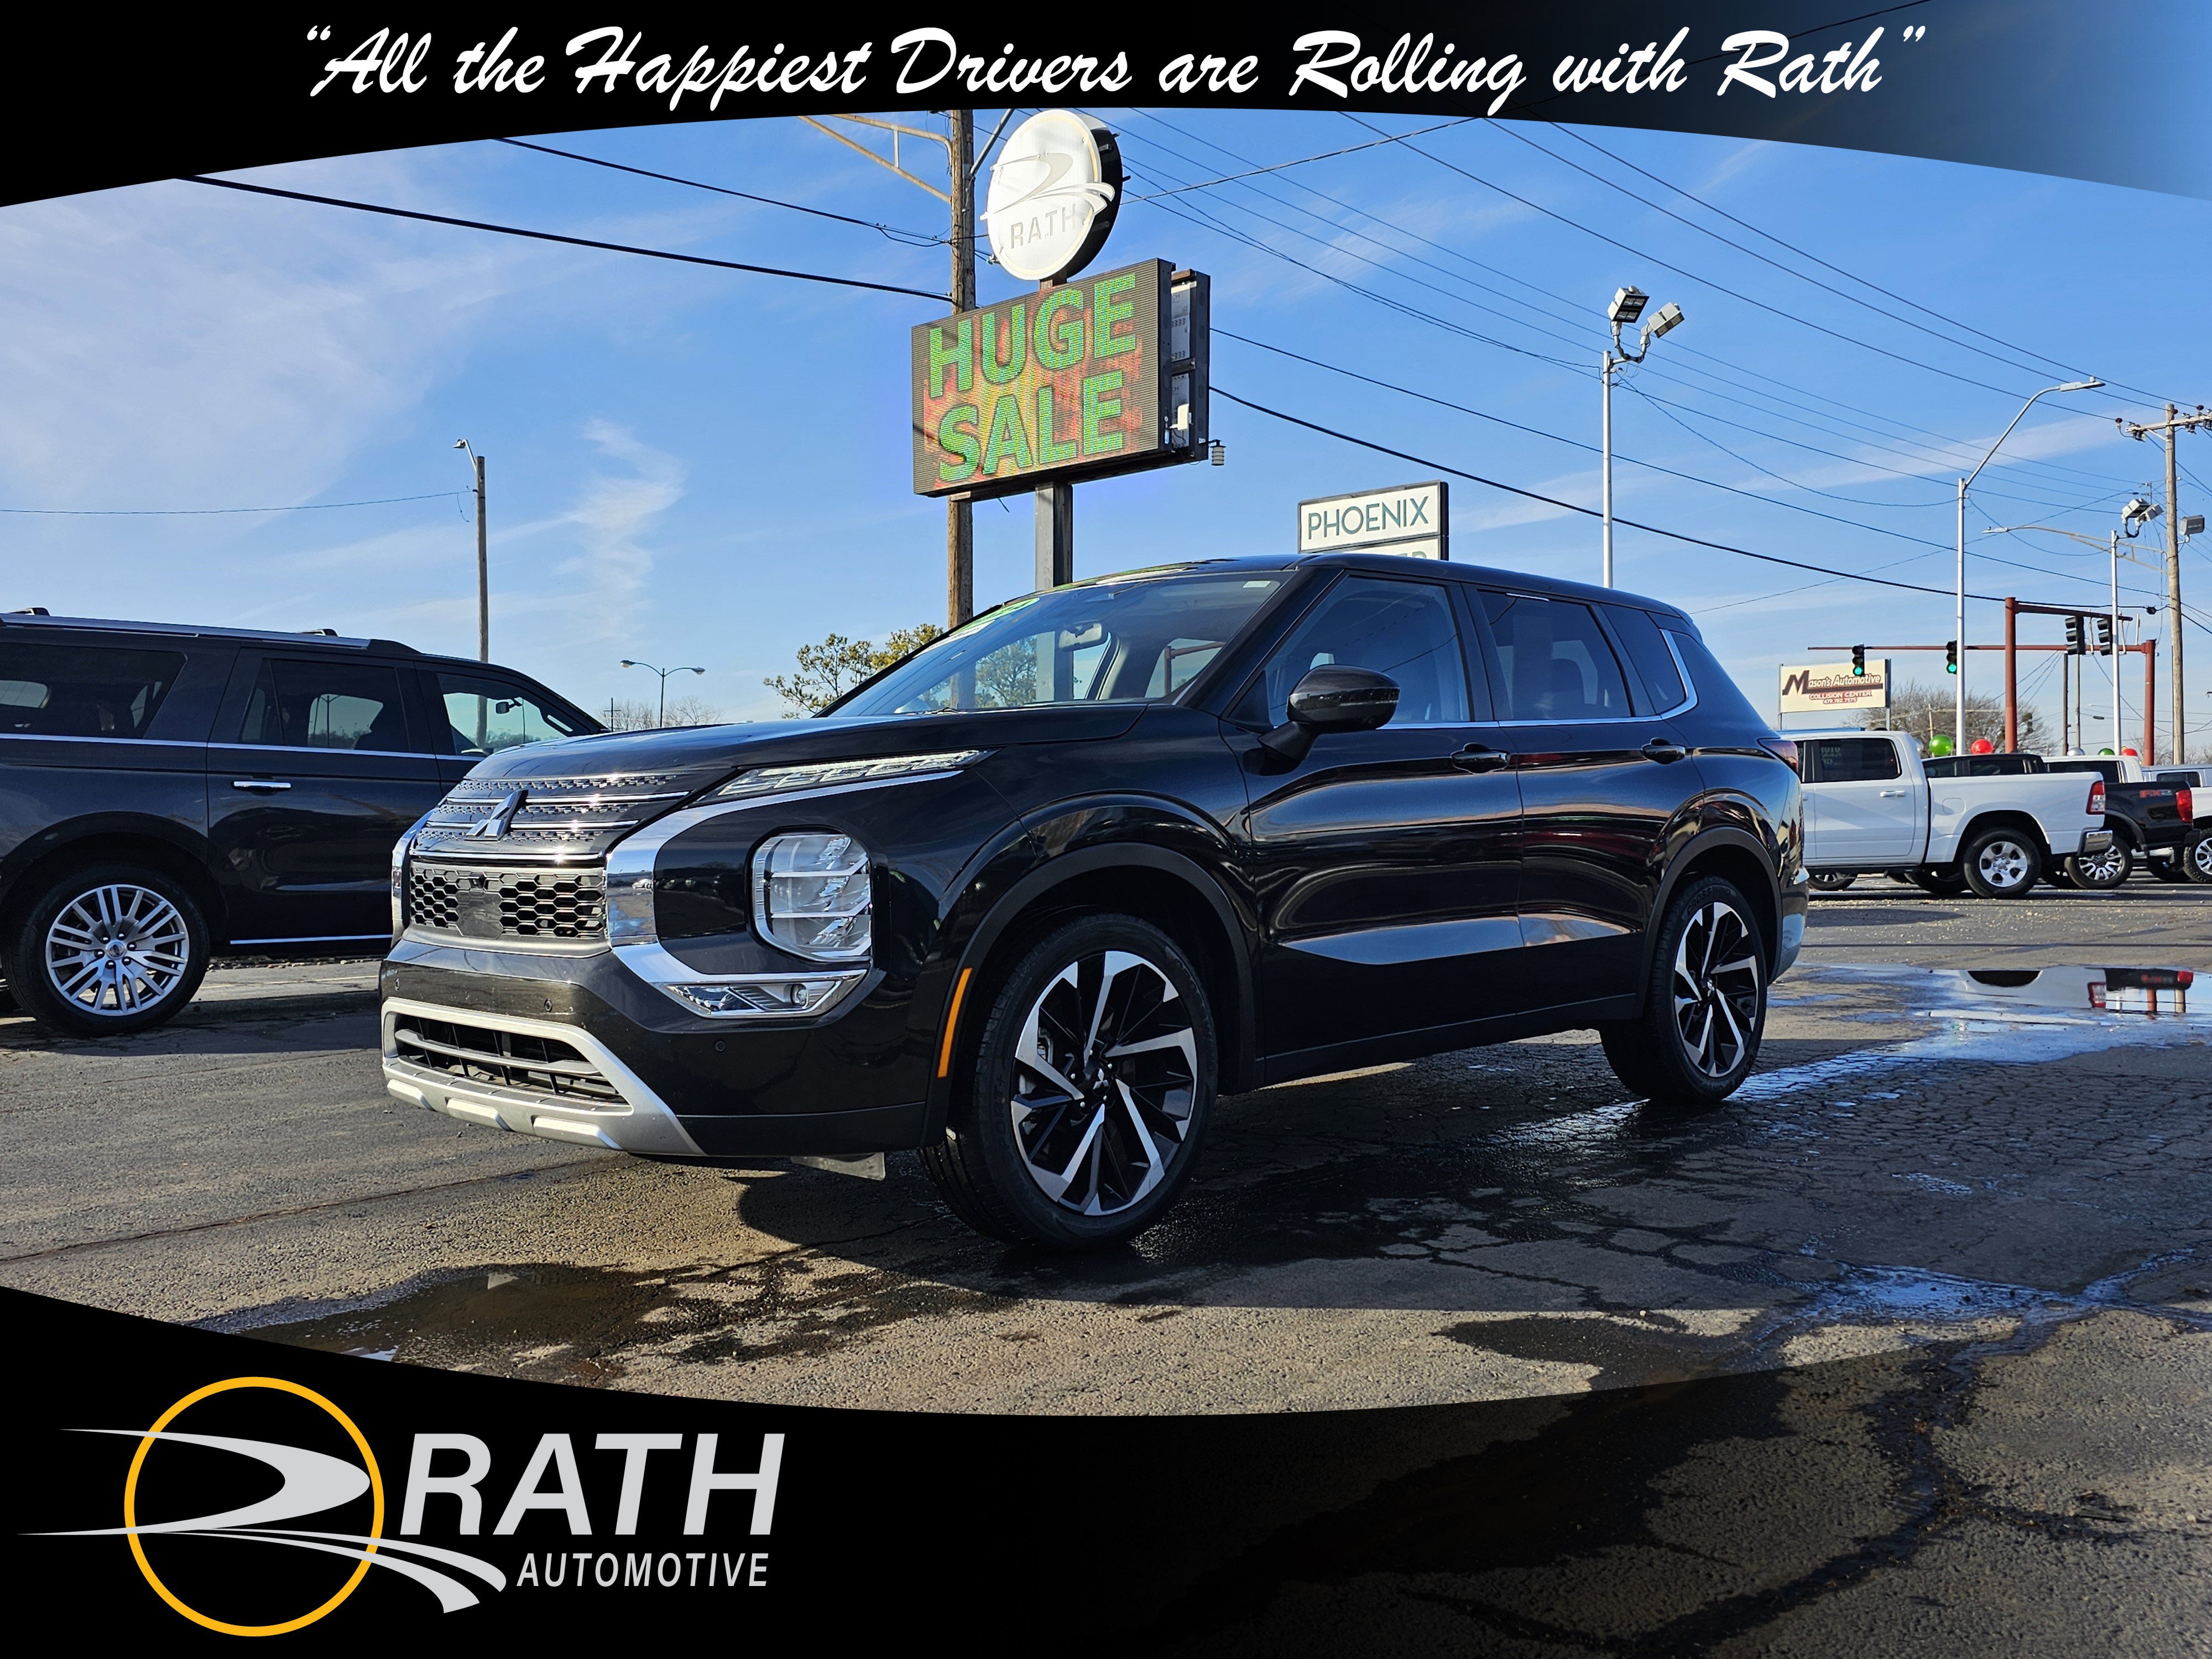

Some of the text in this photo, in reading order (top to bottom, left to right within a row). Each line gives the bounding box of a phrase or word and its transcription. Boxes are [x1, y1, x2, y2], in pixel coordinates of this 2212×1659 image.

[1011, 203, 1076, 249] RATH
[930, 273, 1136, 399] HUGE
[938, 370, 1123, 481] SALE
[1308, 495, 1429, 540] PHOENIX
[1782, 670, 1881, 695] Mason's Automotive
[1809, 692, 1843, 700] COLLISION
